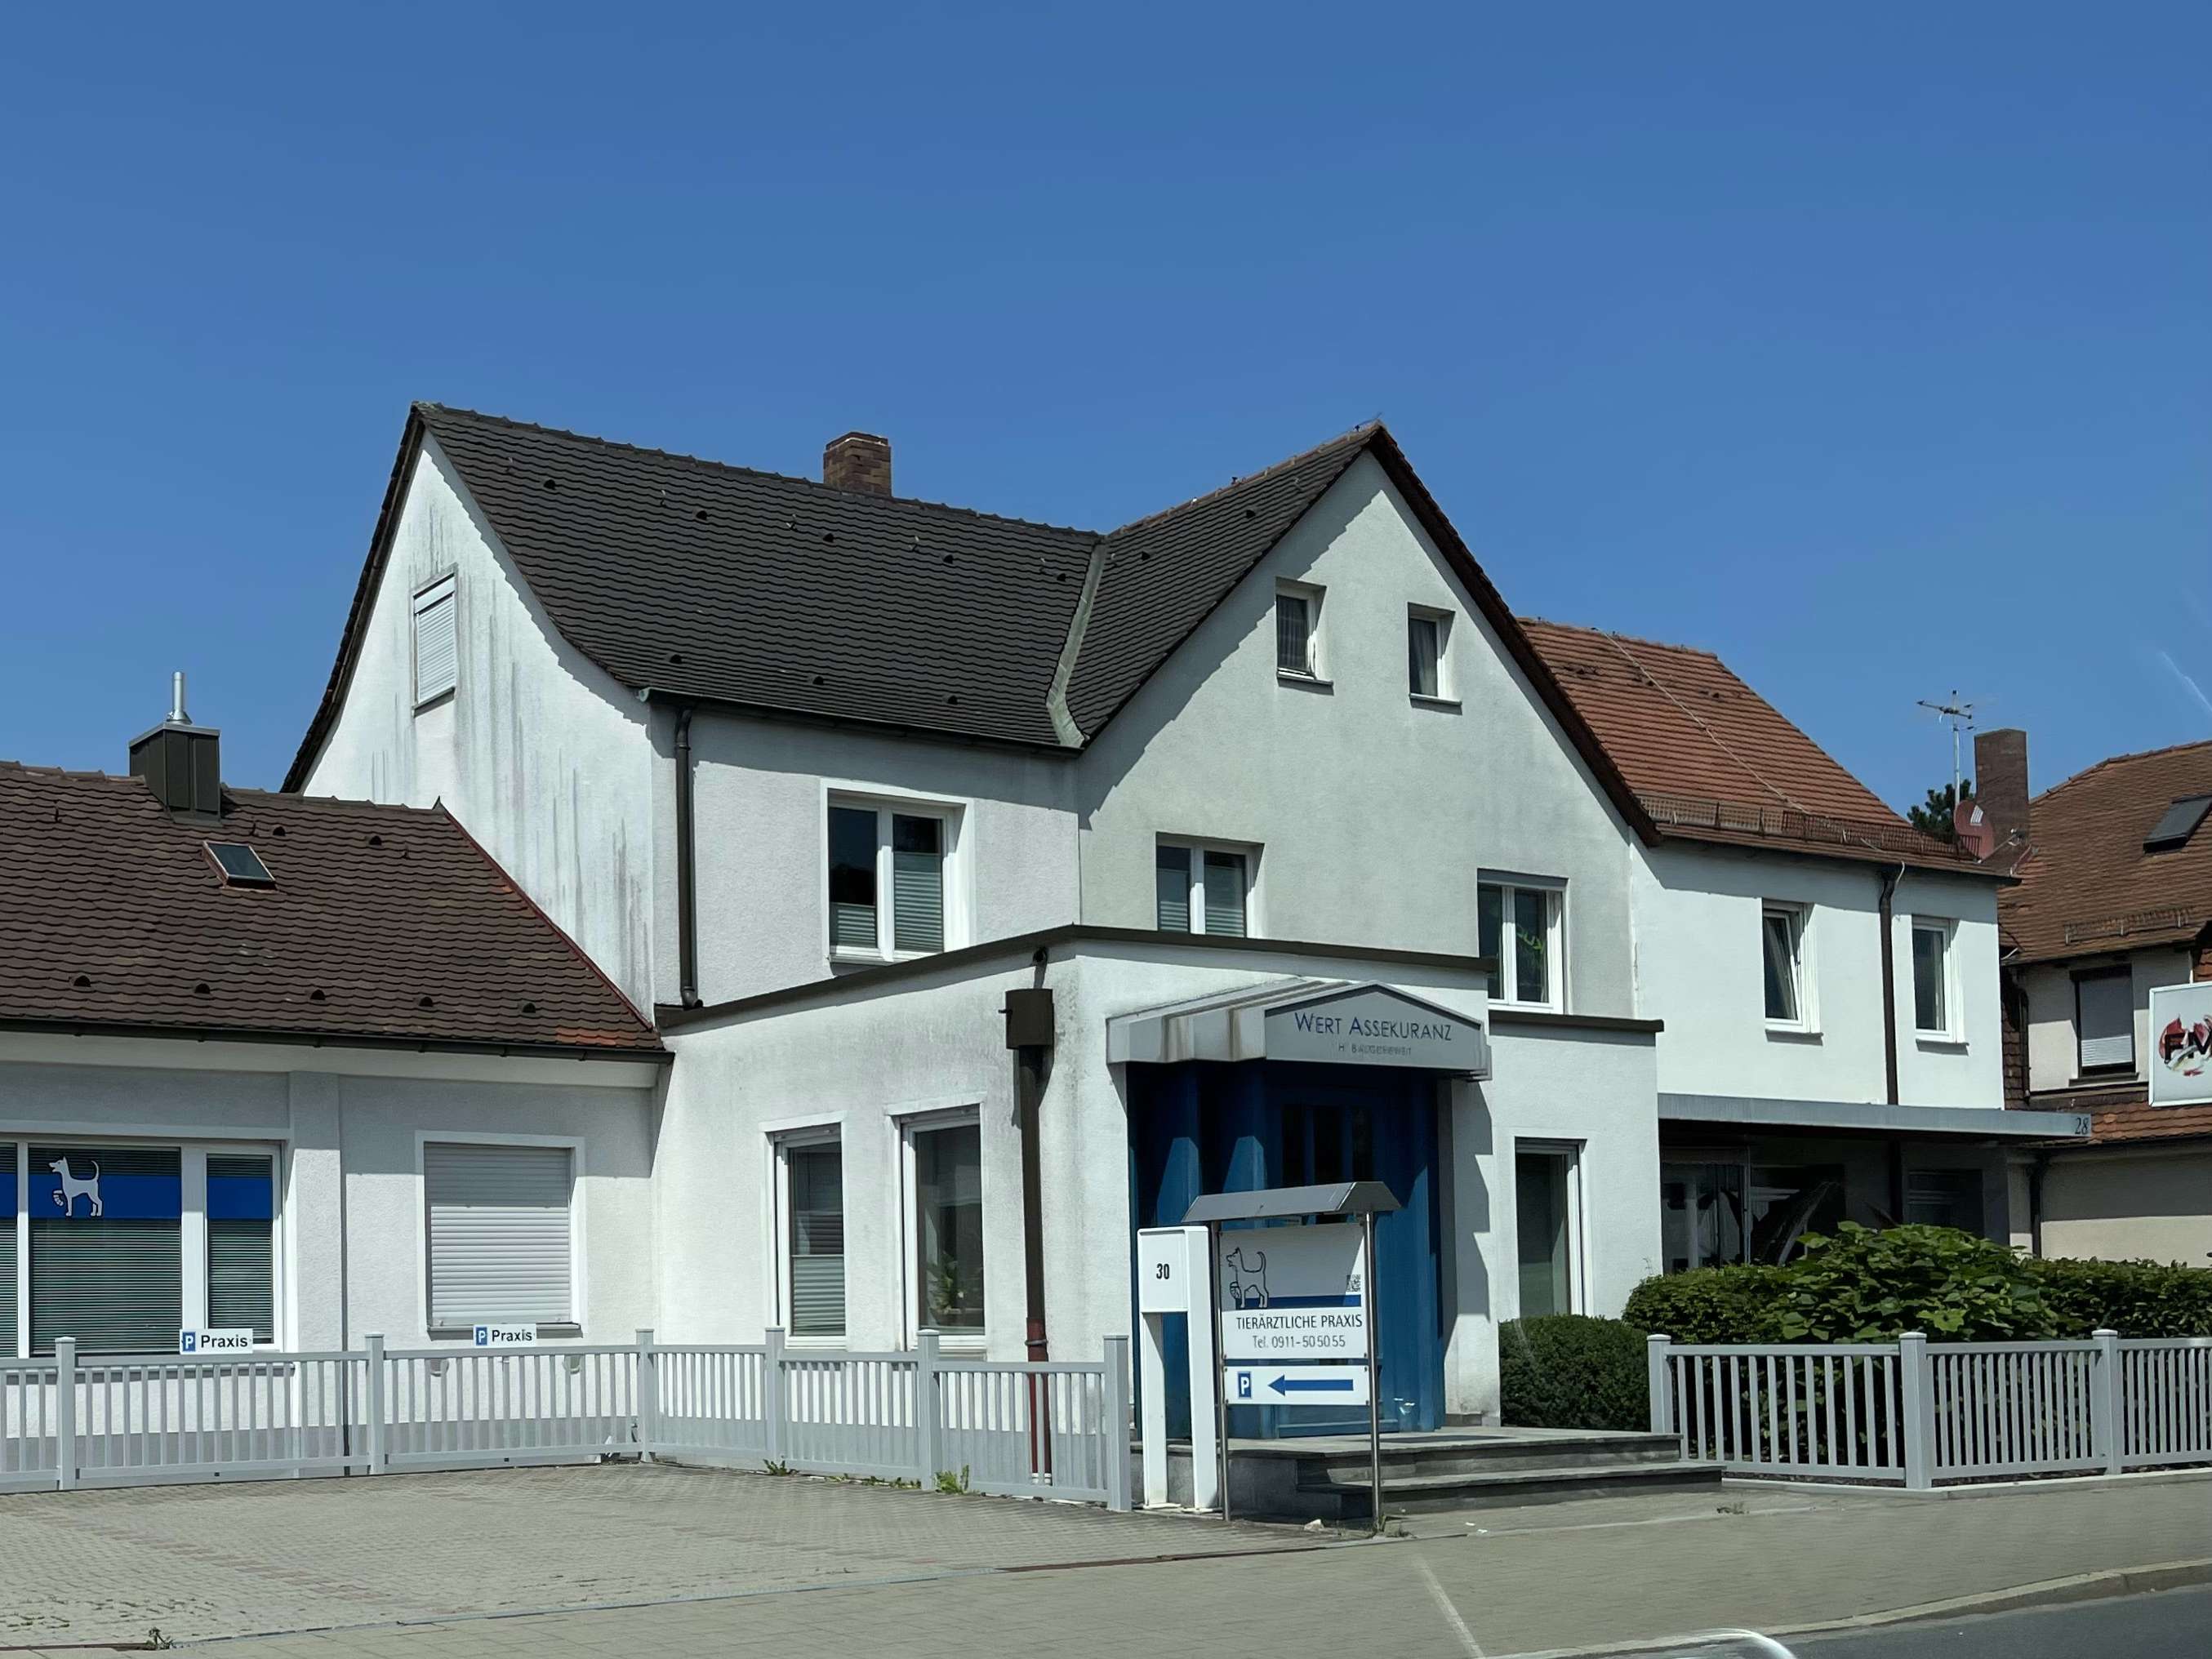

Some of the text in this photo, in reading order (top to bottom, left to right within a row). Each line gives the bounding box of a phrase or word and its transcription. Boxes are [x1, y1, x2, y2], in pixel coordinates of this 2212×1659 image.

[1294, 1012, 1453, 1042] WERT ASSEKURANZ
[2074, 1117, 2090, 1135] 28
[1156, 1262, 1170, 1280] 30
[1236, 1313, 1363, 1329] TIERÄRZTLICHE PRAXIS
[201, 1334, 248, 1348] Praxis
[492, 1328, 532, 1342] Praxis
